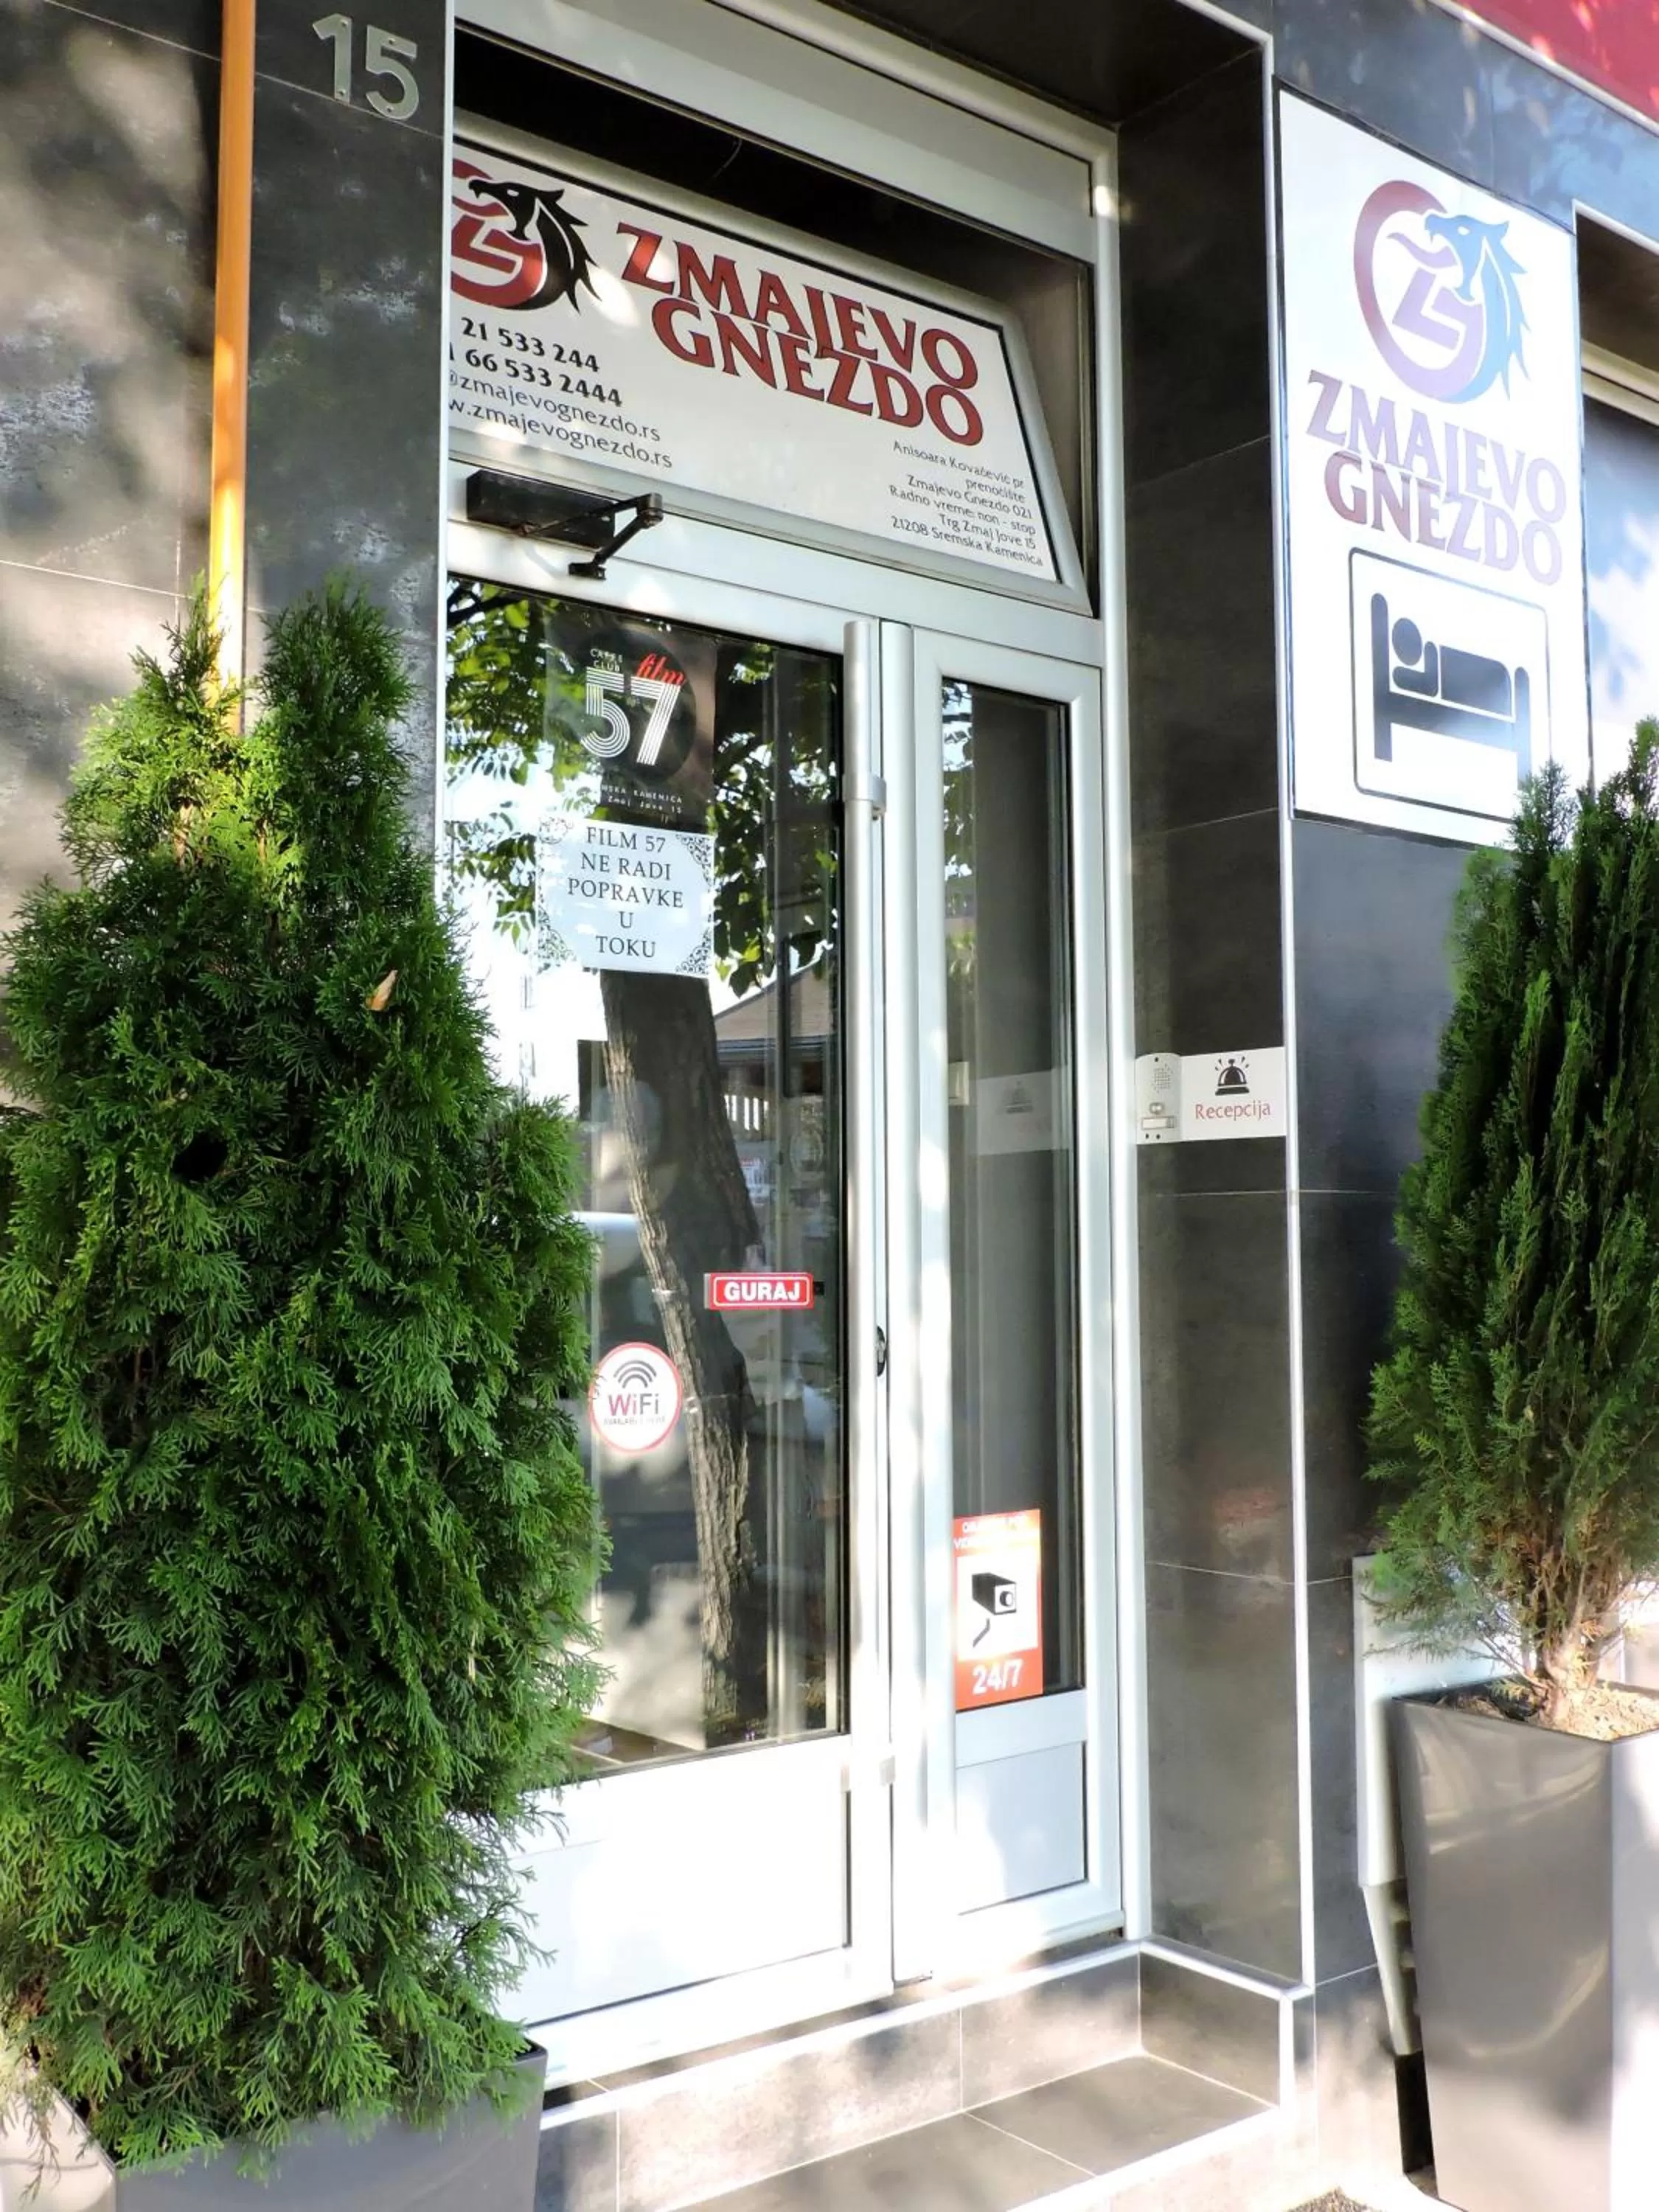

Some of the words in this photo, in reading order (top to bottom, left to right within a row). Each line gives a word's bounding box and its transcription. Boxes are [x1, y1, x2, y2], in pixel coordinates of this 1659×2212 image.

[313, 13, 420, 120] 15
[461, 316, 487, 341] 21
[498, 327, 545, 356] 533
[552, 343, 600, 372] 244
[465, 349, 498, 372] 66
[504, 358, 552, 387] 533
[559, 374, 622, 407] 2444
[651, 297, 984, 446] GNEZDO
[889, 484, 931, 507] Radno
[933, 498, 976, 518] vreme
[978, 510, 1001, 526] non
[1010, 519, 1036, 536] stop
[907, 474, 961, 499] Zmajevo
[964, 491, 1011, 515] Gnezdo
[1012, 504, 1033, 521] 021
[939, 512, 961, 532] Trg
[963, 520, 994, 542] Zmaj
[1324, 450, 1563, 586] GNEZDO
[891, 515, 930, 537] 21208
[931, 526, 983, 552] Sremska
[985, 540, 1043, 567] Kamenica
[636, 652, 685, 686] film
[580, 666, 681, 766] 57
[586, 827, 638, 851] FILM
[645, 835, 667, 853] 57
[581, 852, 611, 873] NE
[618, 858, 671, 881] RADI
[568, 877, 684, 908] POPRAVKE
[619, 911, 633, 929] U
[595, 935, 655, 958] TOKU
[1194, 1099, 1271, 1121] Recepcija
[723, 1281, 801, 1302] GURAJ
[608, 1392, 660, 1416] WiFi
[972, 1659, 1023, 1696] 24/7
